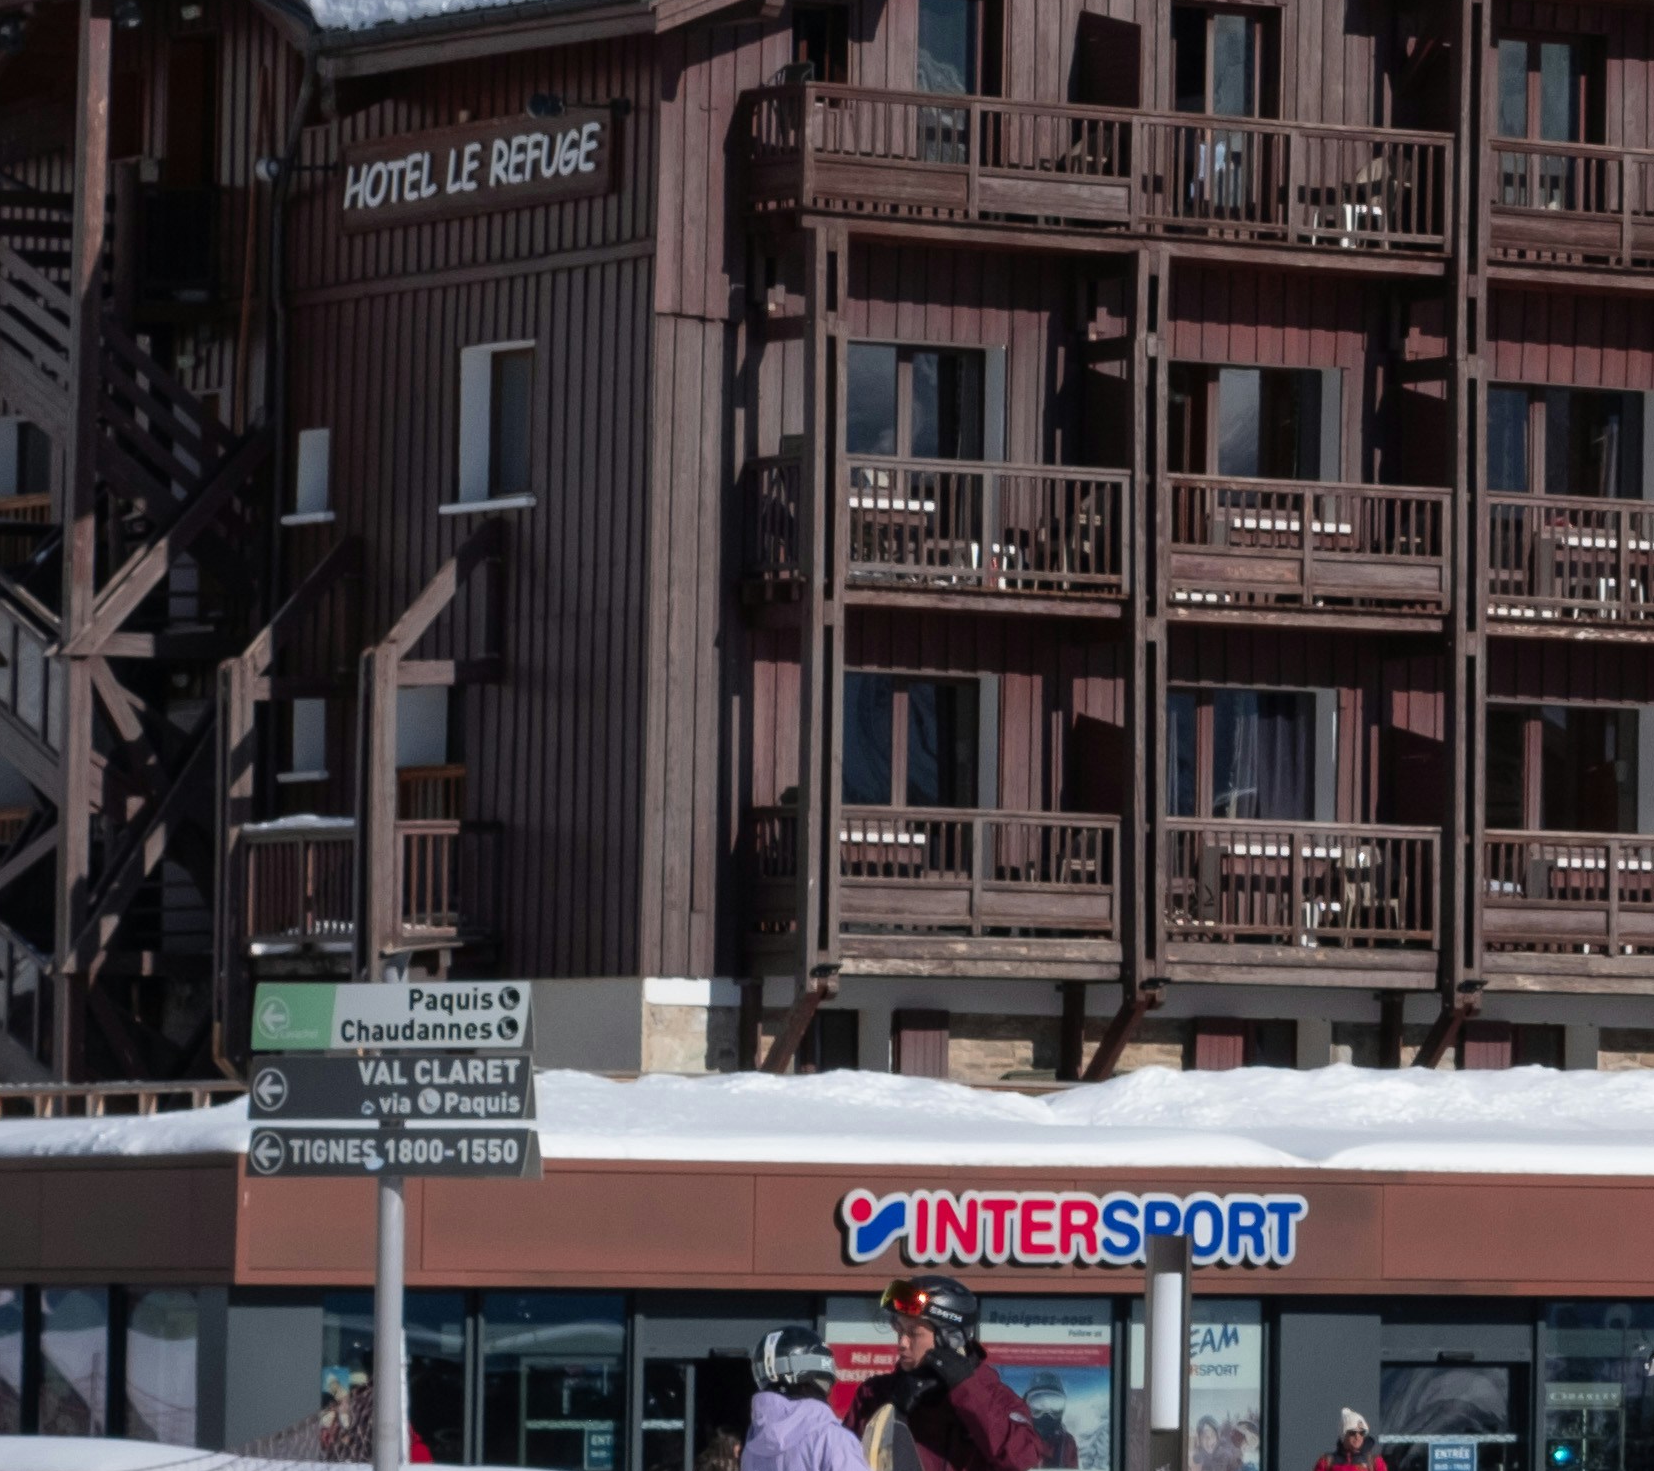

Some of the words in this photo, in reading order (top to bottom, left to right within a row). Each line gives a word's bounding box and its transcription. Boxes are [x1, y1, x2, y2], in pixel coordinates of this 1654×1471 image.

[343, 151, 437, 211] HOTEL
[446, 142, 479, 193] LE
[488, 121, 603, 188] REFUGE
[409, 987, 494, 1016] Paquis
[340, 1019, 493, 1042] Chaudannes
[358, 1059, 408, 1086] VAL
[414, 1059, 521, 1085] CLARET
[378, 1092, 412, 1115] via
[444, 1091, 521, 1117] Paquis
[289, 1138, 379, 1164] TIGNES
[384, 1138, 519, 1164] 1800-1550
[913, 1194, 1306, 1263] INTERSPORT
[929, 1304, 963, 1323] SMITH
[1189, 1321, 1240, 1357] EAM
